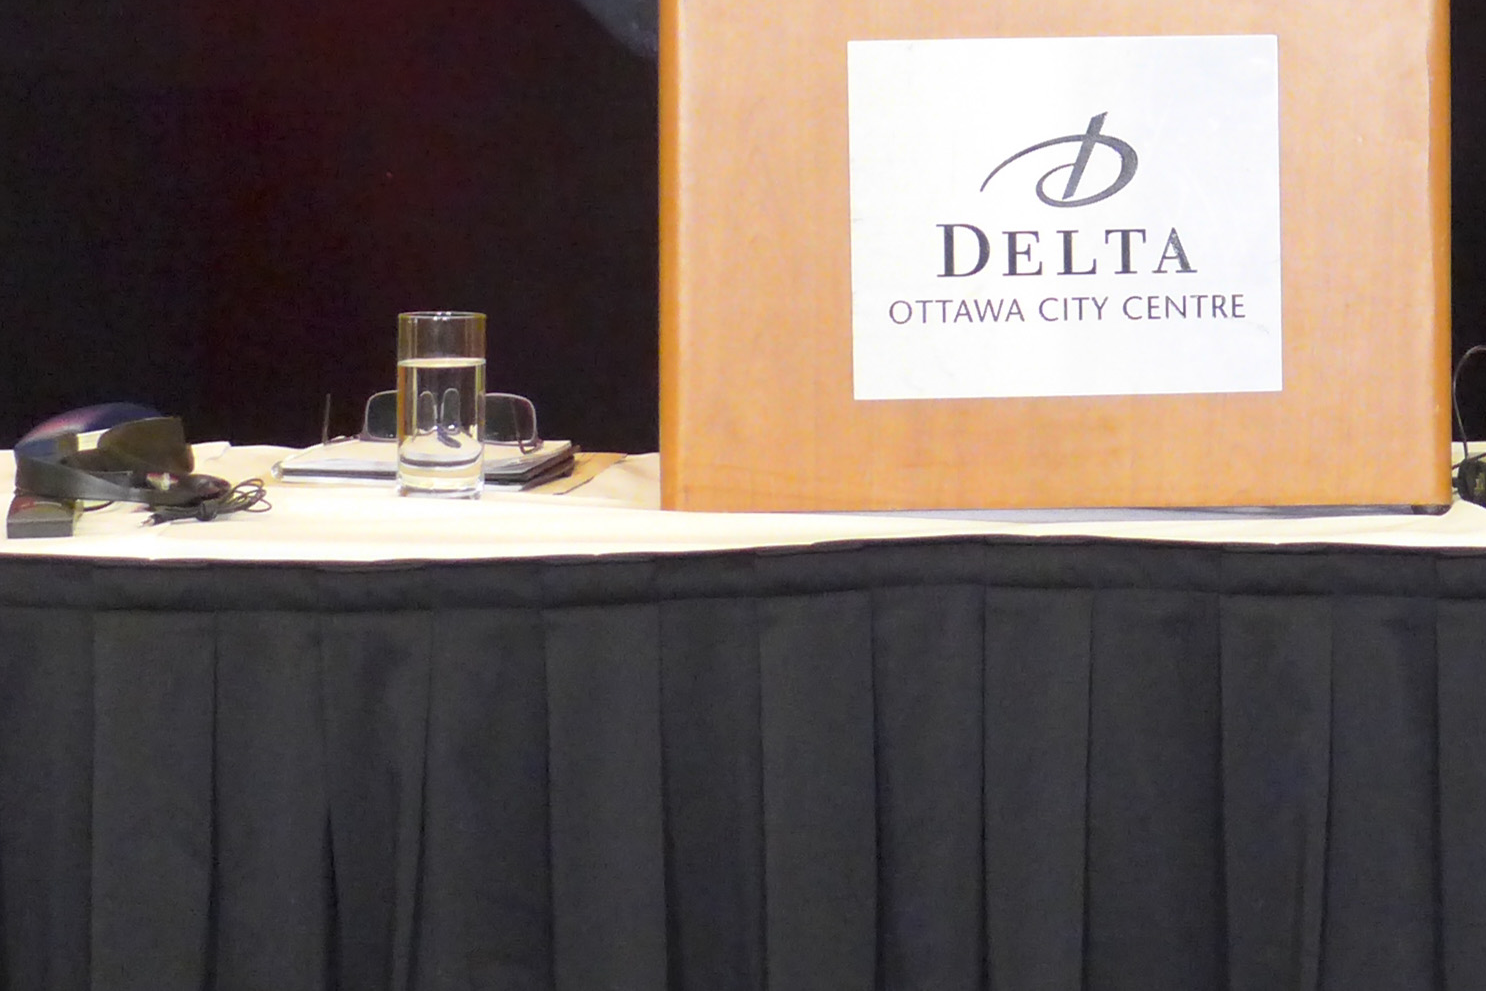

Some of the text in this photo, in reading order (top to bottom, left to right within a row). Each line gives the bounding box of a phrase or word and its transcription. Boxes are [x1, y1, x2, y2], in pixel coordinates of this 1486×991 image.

[935, 222, 1198, 278] DELTA
[888, 293, 1247, 325] OTTAWA CITY CENTRE
